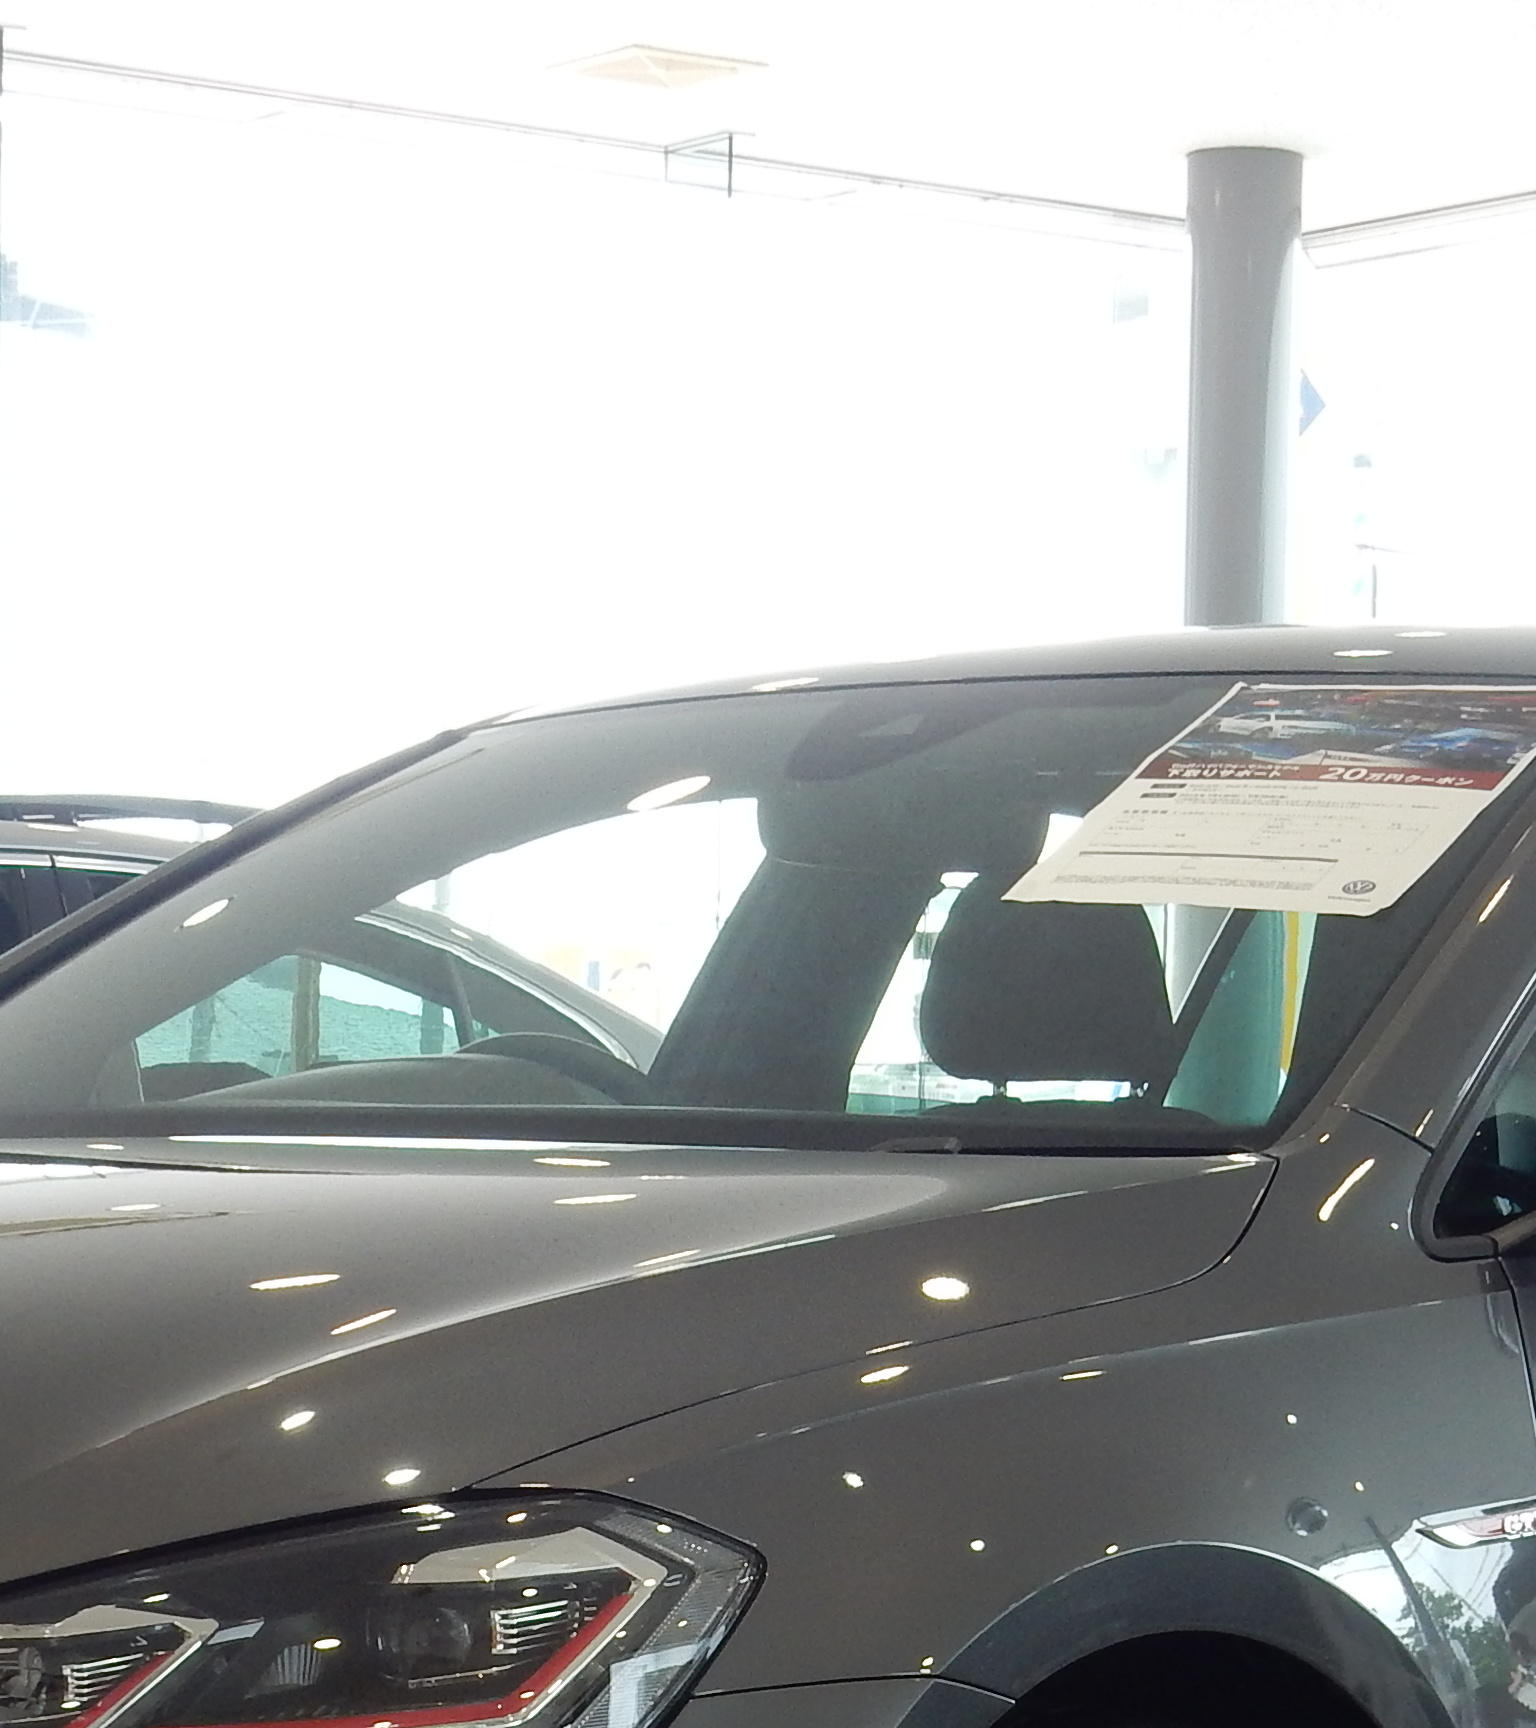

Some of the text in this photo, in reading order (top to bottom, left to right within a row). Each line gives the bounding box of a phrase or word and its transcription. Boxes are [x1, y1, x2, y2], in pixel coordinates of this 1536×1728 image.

[1318, 767, 1475, 786] 20万円クーポン
